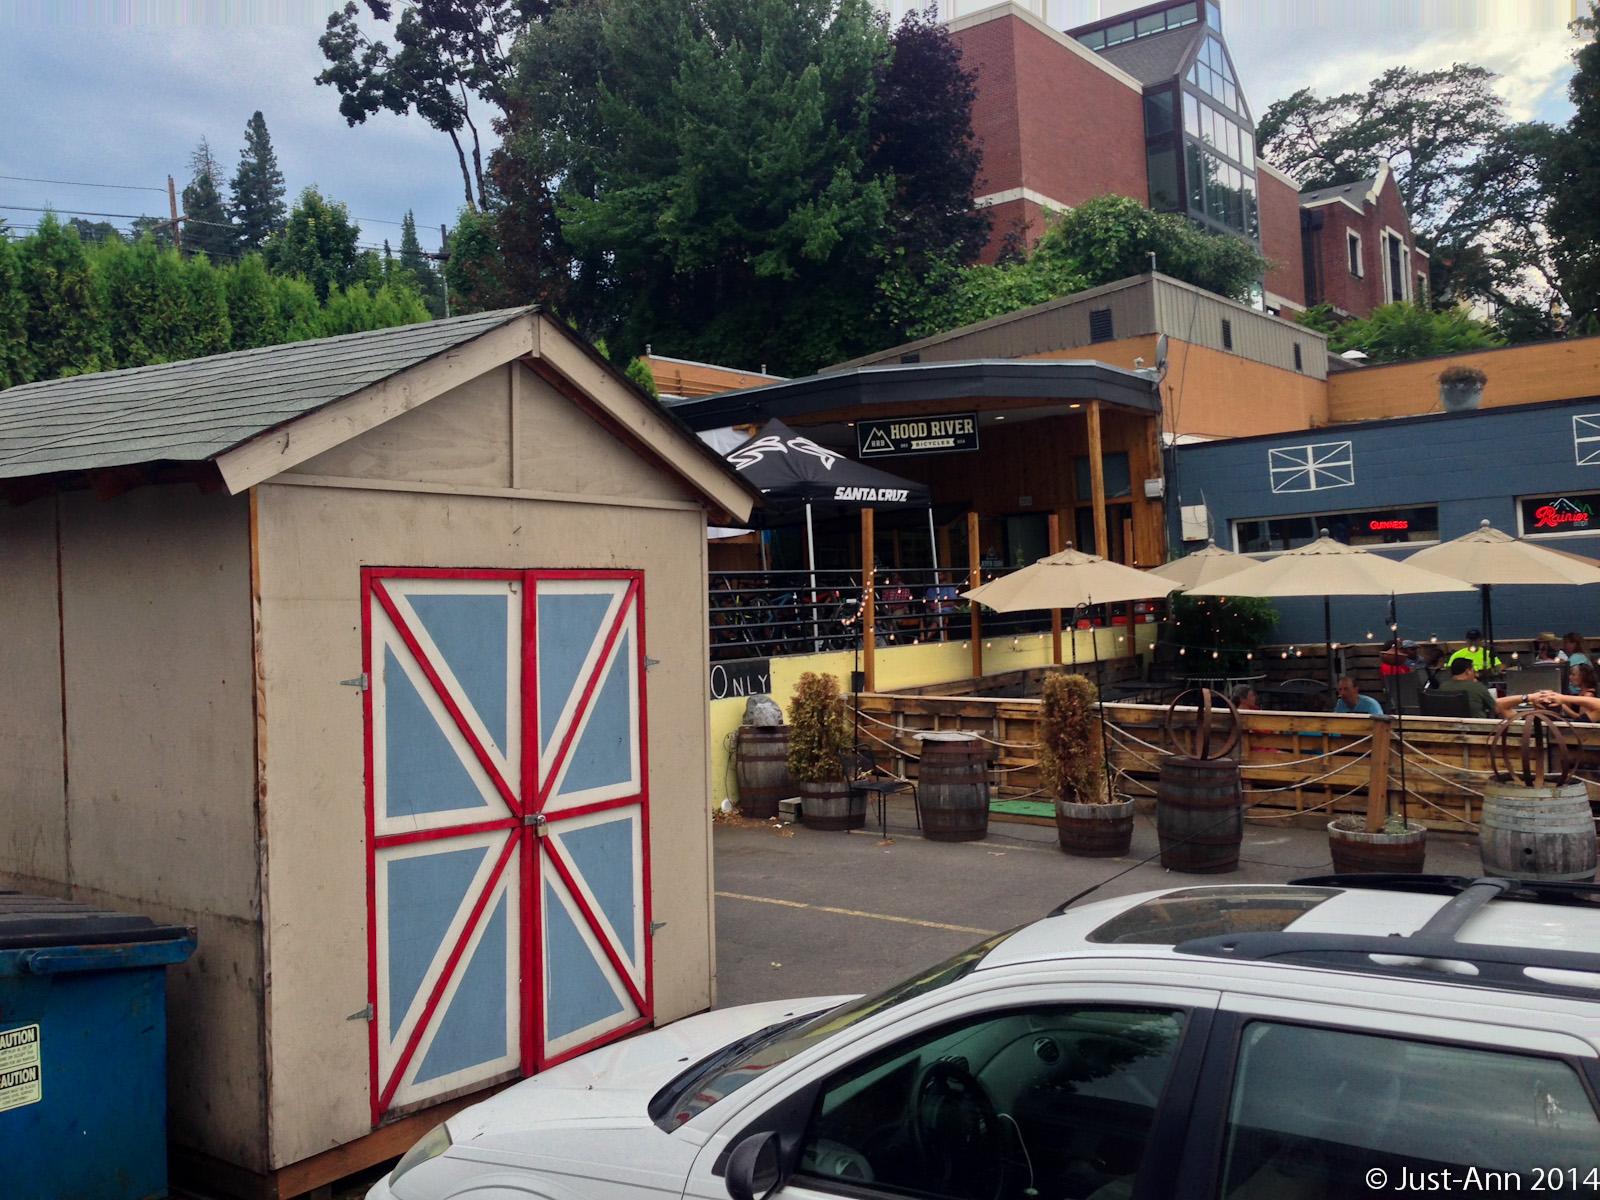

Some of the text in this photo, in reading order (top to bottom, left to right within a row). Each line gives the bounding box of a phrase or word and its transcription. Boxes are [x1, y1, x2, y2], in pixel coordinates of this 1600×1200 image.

[890, 419, 974, 439] HOOD RIVER
[834, 486, 909, 502] SANTA CRUZ
[1534, 505, 1589, 528] Rainier
[0, 1028, 35, 1049] AUTION
[0, 1066, 36, 1089] AUTION
